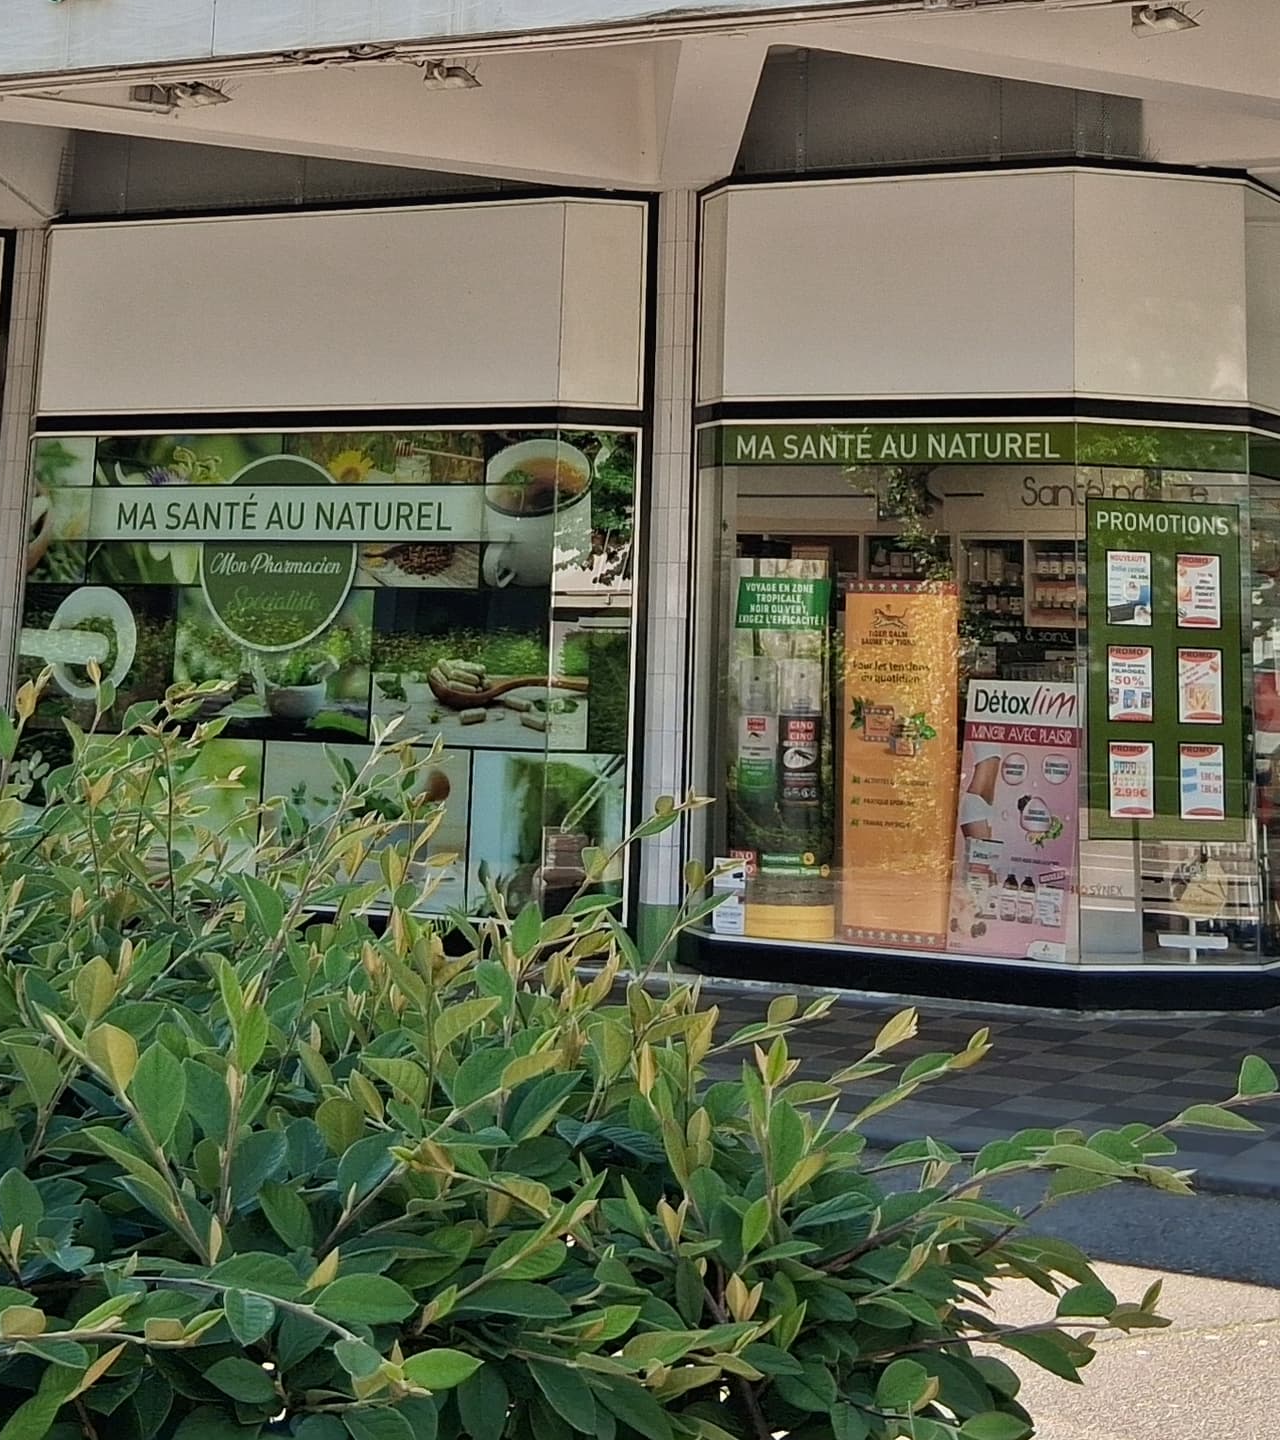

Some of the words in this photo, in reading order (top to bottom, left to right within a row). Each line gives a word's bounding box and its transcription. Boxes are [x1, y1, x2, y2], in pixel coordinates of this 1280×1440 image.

[736, 435, 775, 459] MA
[783, 427, 873, 459] SANTÉ
[880, 433, 917, 459] AU
[927, 432, 1061, 459] NATUREL
[117, 502, 157, 531] MA
[165, 493, 258, 531] SANTÉ
[265, 501, 305, 531] AU
[315, 501, 453, 531] NATUREL
[1096, 511, 1230, 536] PROMOTIONS
[210, 551, 249, 575] Mon
[251, 552, 343, 575] Pharmacien
[745, 582, 777, 593] VOYAGE
[778, 583, 791, 593] EN
[791, 583, 814, 594] ZONE
[1109, 647, 1144, 656] PROMO
[1008, 727, 1037, 743] AVEC
[1110, 745, 1144, 754] PROMO
[1181, 745, 1214, 754] PROMO
